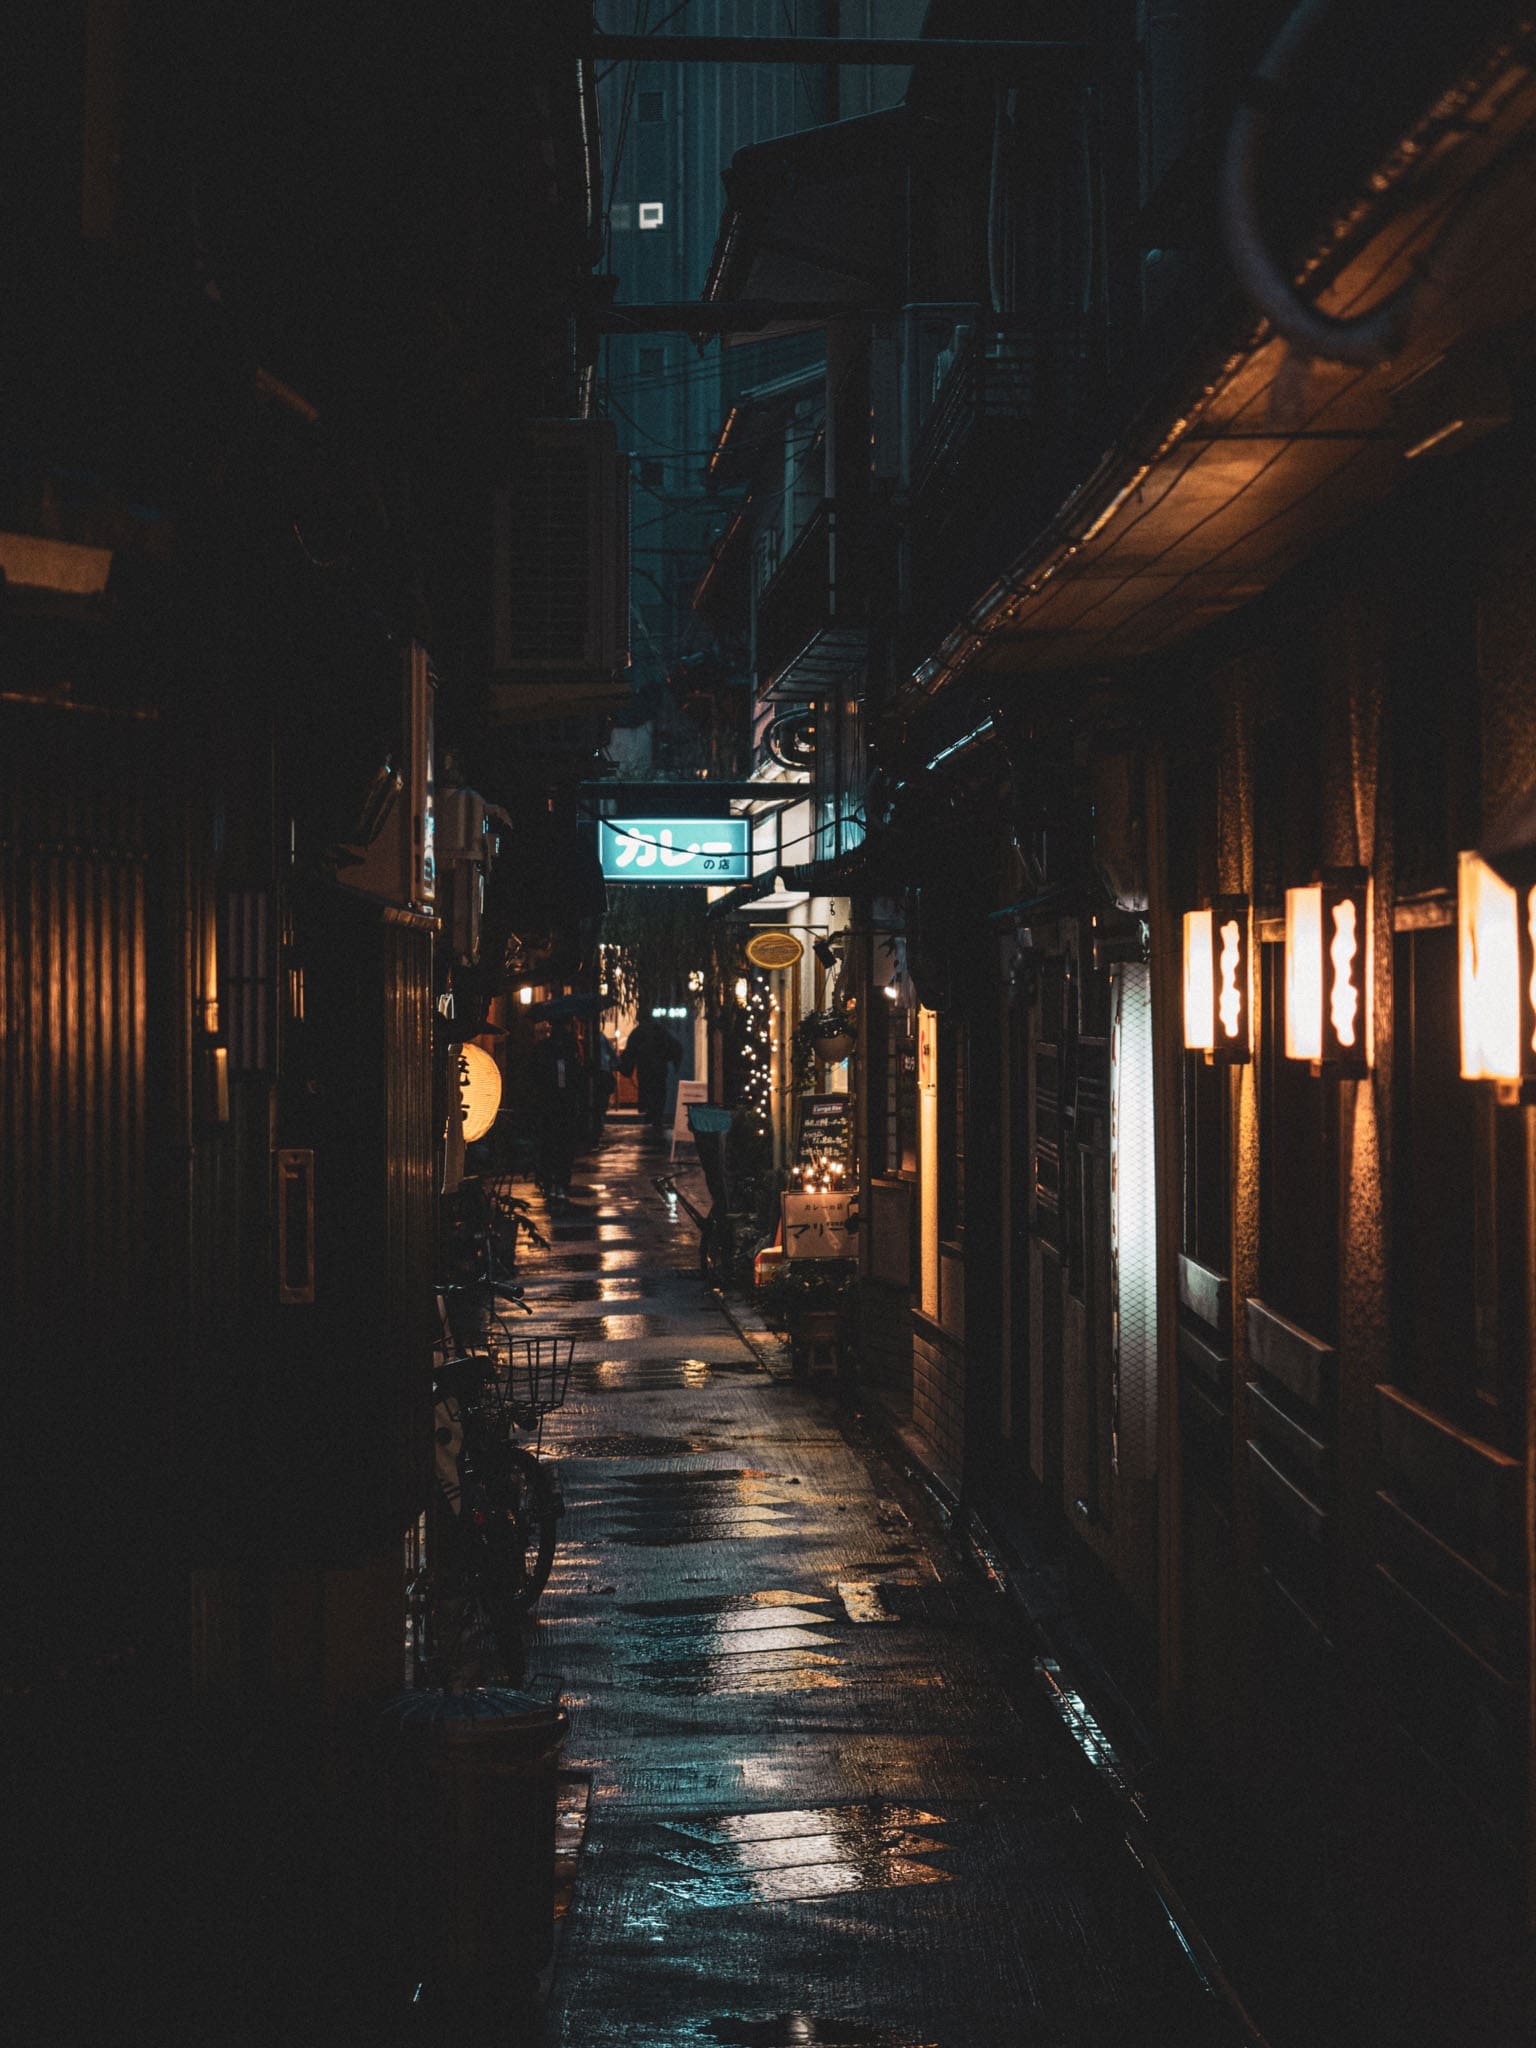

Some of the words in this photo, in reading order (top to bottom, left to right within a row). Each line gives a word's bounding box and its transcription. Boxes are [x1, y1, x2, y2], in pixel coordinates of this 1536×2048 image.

[614, 827, 733, 868] カレー
[703, 859, 731, 870] の店
